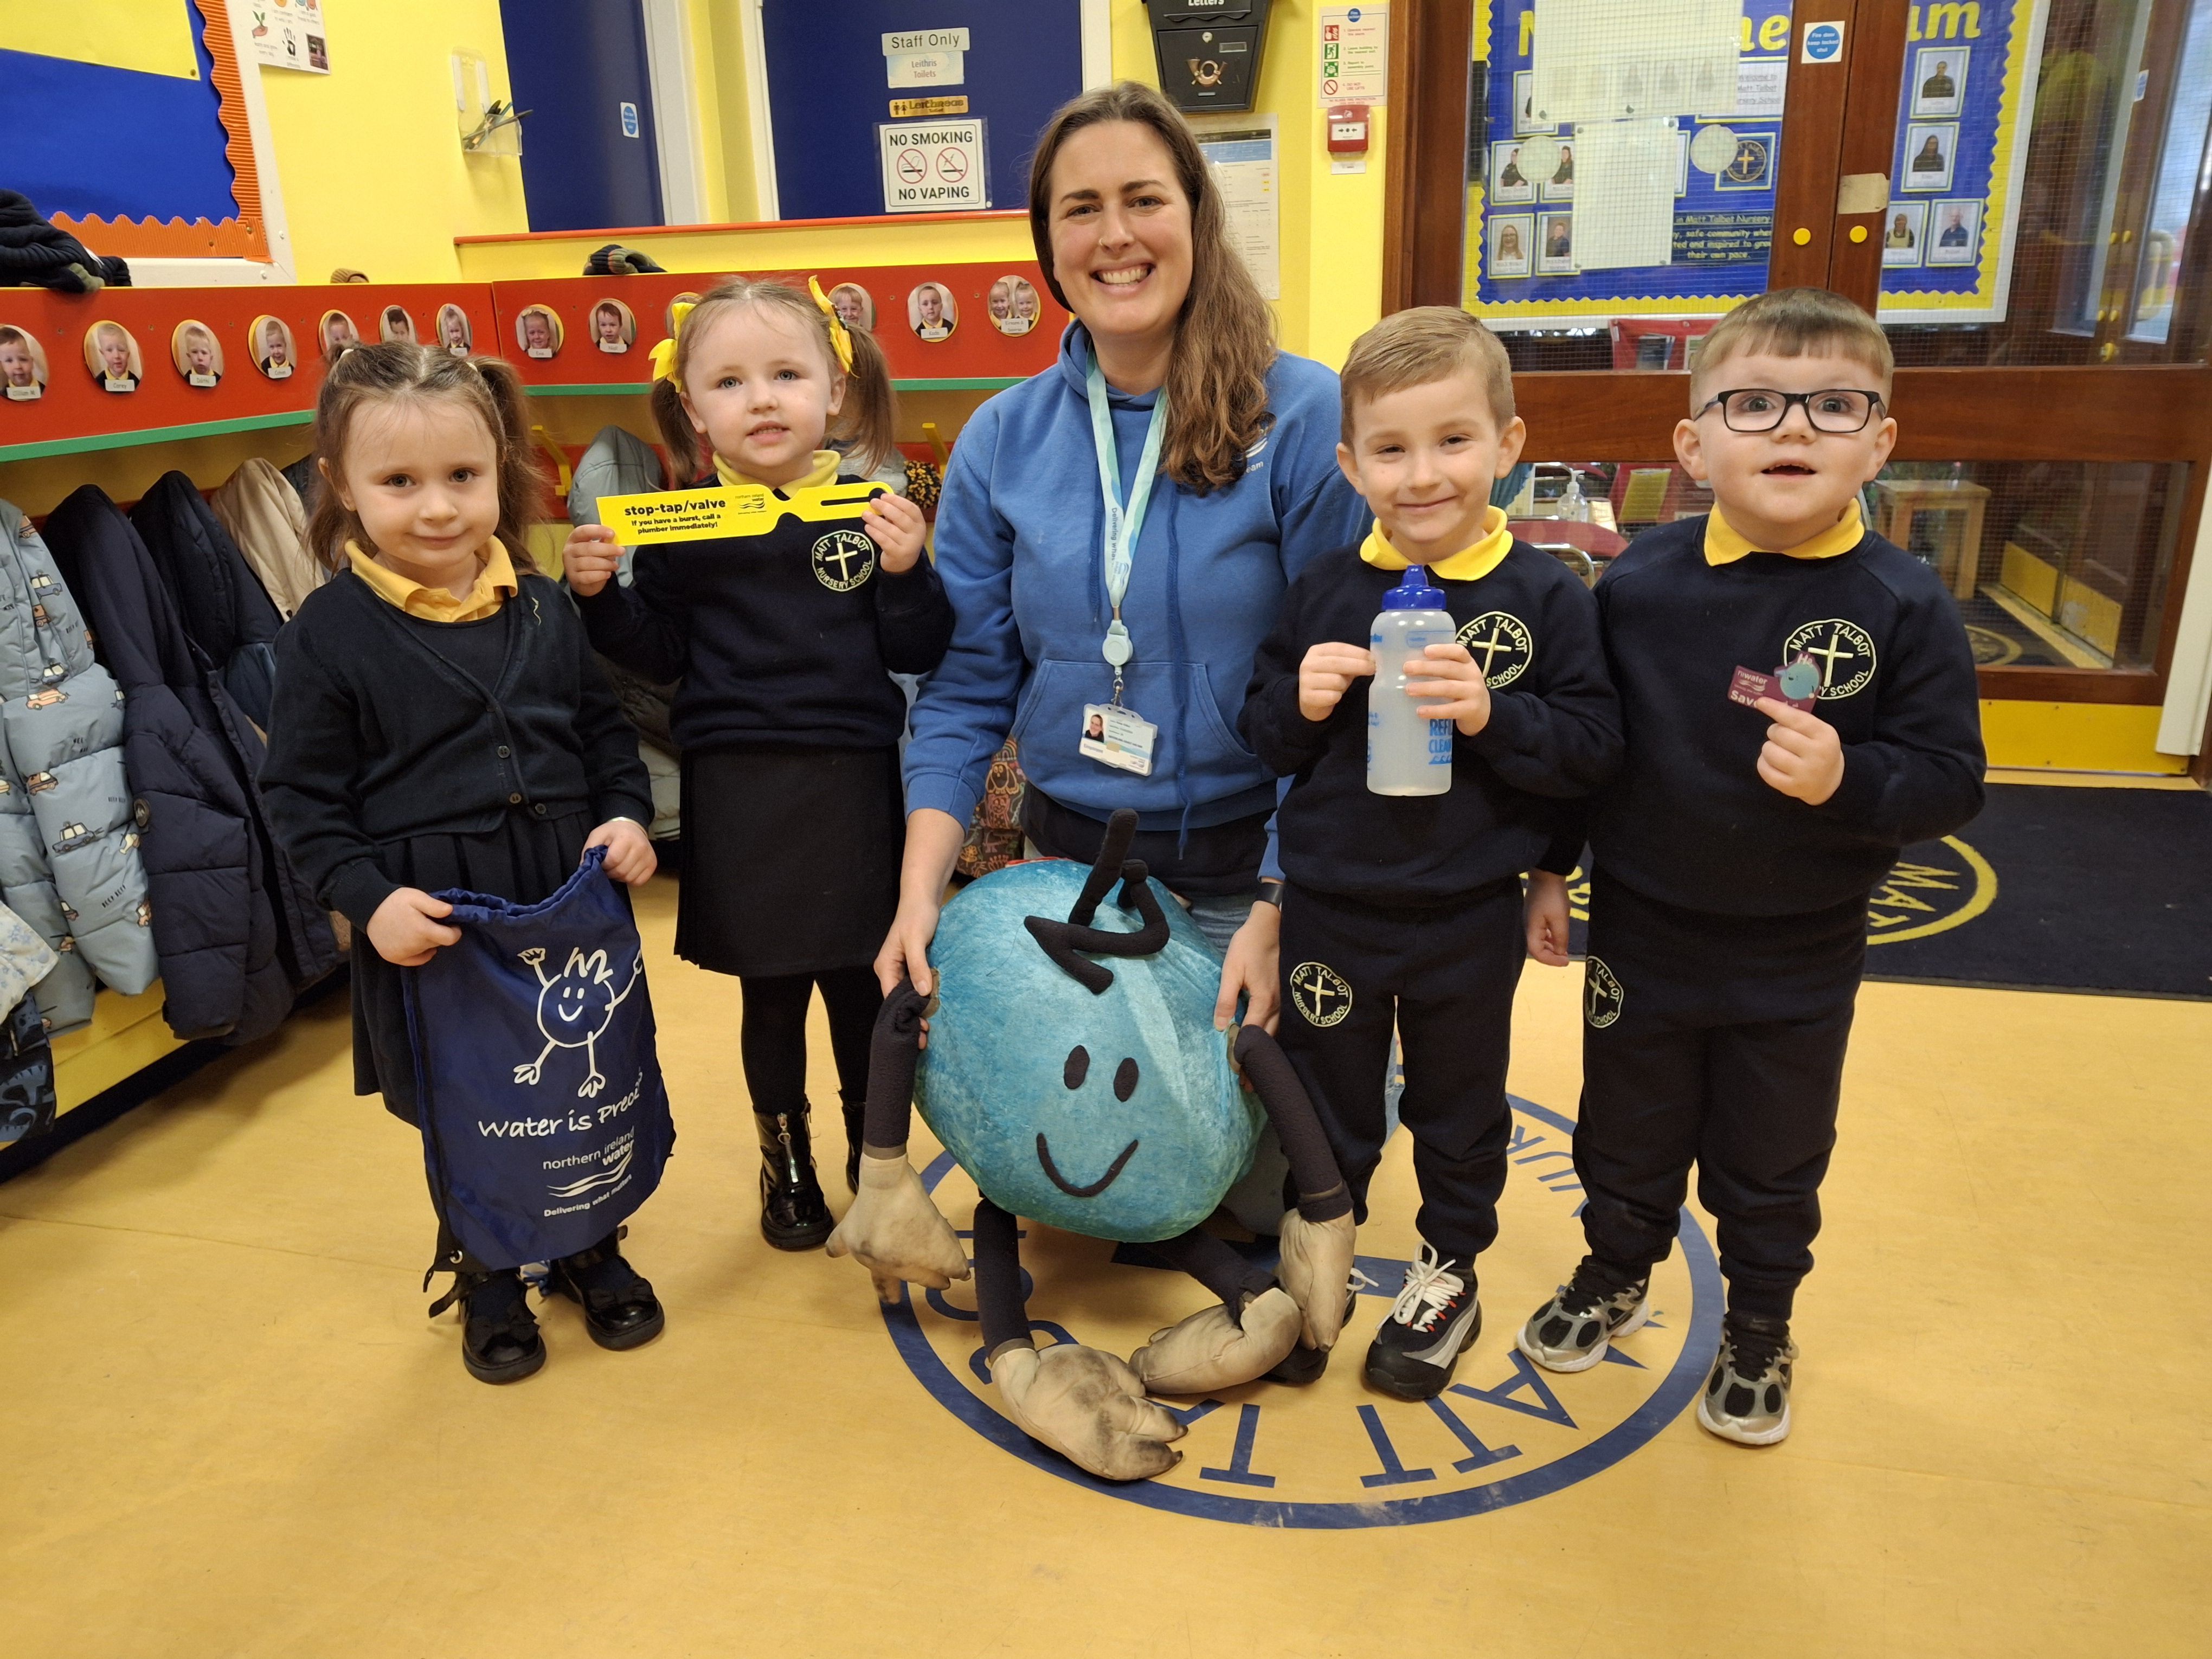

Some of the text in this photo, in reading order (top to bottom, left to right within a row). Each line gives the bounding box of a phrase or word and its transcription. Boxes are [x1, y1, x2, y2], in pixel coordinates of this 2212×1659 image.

[891, 33, 960, 49] Staff Only
[911, 59, 937, 68] Leithris
[914, 70, 937, 79] Toilets
[889, 131, 973, 146] NO SMOKING
[898, 186, 970, 200] NO VAPING
[1246, 460, 1264, 474] eam
[624, 499, 726, 516] stop-tap/valve
[637, 526, 668, 535] plumber
[638, 519, 653, 527] you
[679, 515, 702, 523] burst,
[814, 539, 831, 562] MATT
[834, 533, 870, 551] TALBOT
[817, 567, 848, 589] NURSERY
[849, 560, 872, 586] SCHOOL
[1457, 619, 1488, 647] MATT
[1495, 616, 1528, 653] TALBOT
[1789, 624, 1823, 651] MATT
[1834, 622, 1871, 658] TALBOT
[1486, 663, 1523, 687] SCHOOL
[1830, 670, 1869, 697] SCHOOL
[1293, 966, 1312, 986] MATT
[1315, 966, 1349, 998] TALBOT
[1596, 962, 1620, 1003] TALBOT
[1320, 1004, 1348, 1025] SCHOOL
[478, 1116, 563, 1139] Water
[568, 1109, 593, 1132] is
[543, 1125, 635, 1171] northern ireland
[602, 1140, 635, 1166] water
[544, 1201, 591, 1218] Delivering
[592, 1191, 611, 1206] what
